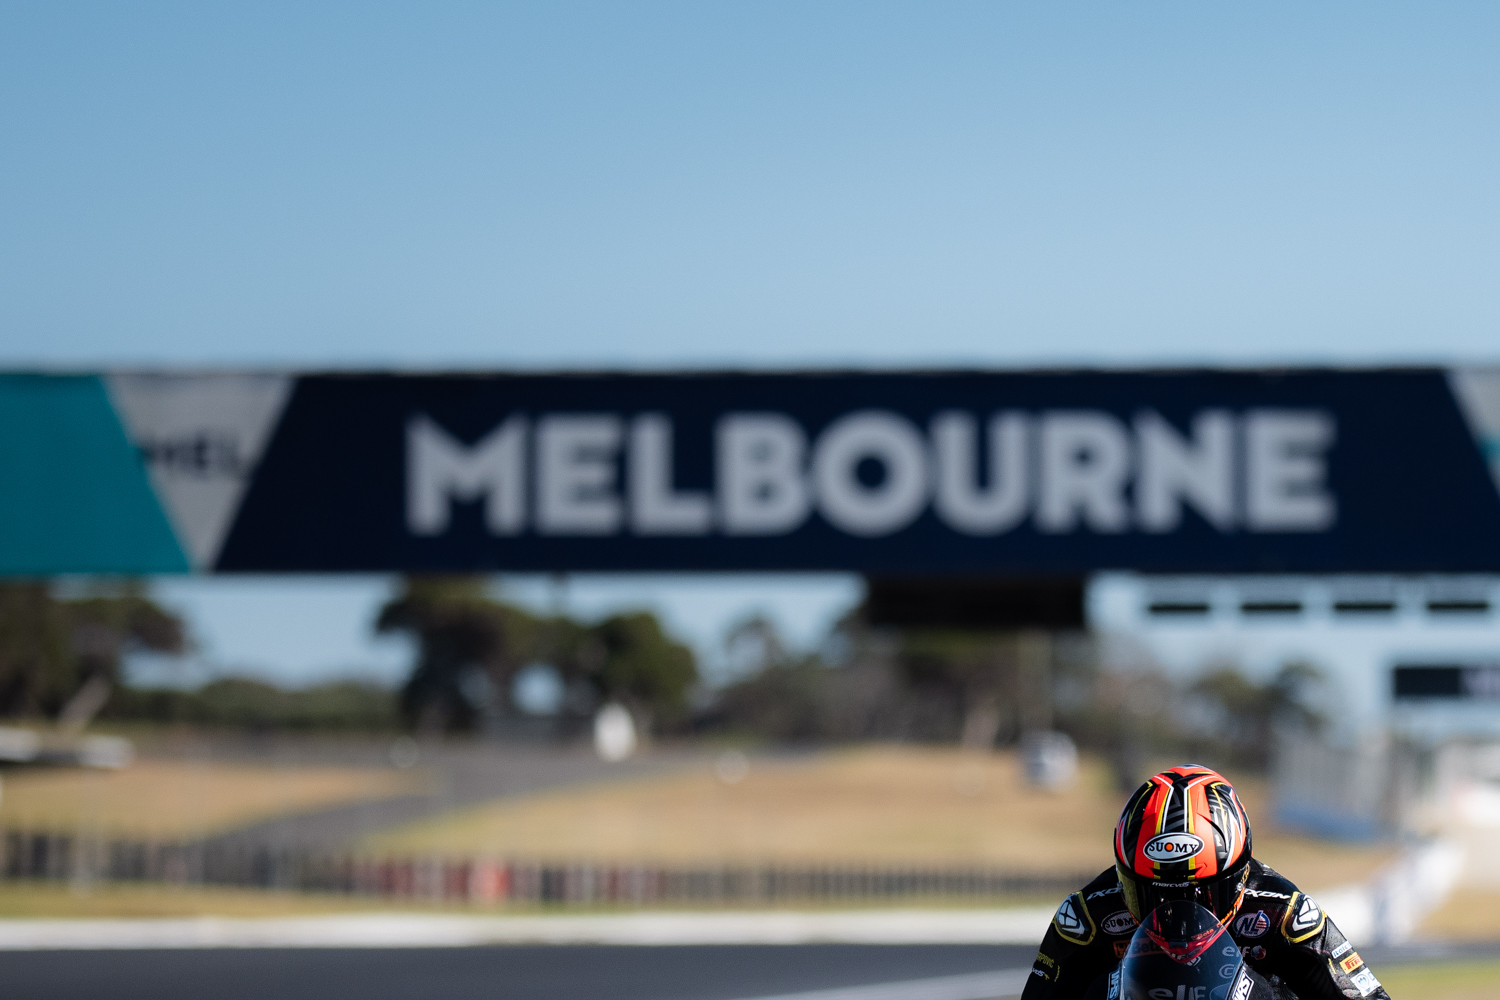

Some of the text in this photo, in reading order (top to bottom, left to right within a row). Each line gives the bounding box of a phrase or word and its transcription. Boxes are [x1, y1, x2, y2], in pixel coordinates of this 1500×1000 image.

[406, 410, 1335, 536] MELBOURNE
[1148, 841, 1199, 855] SUOMY
[1103, 917, 1134, 929] SUOM
